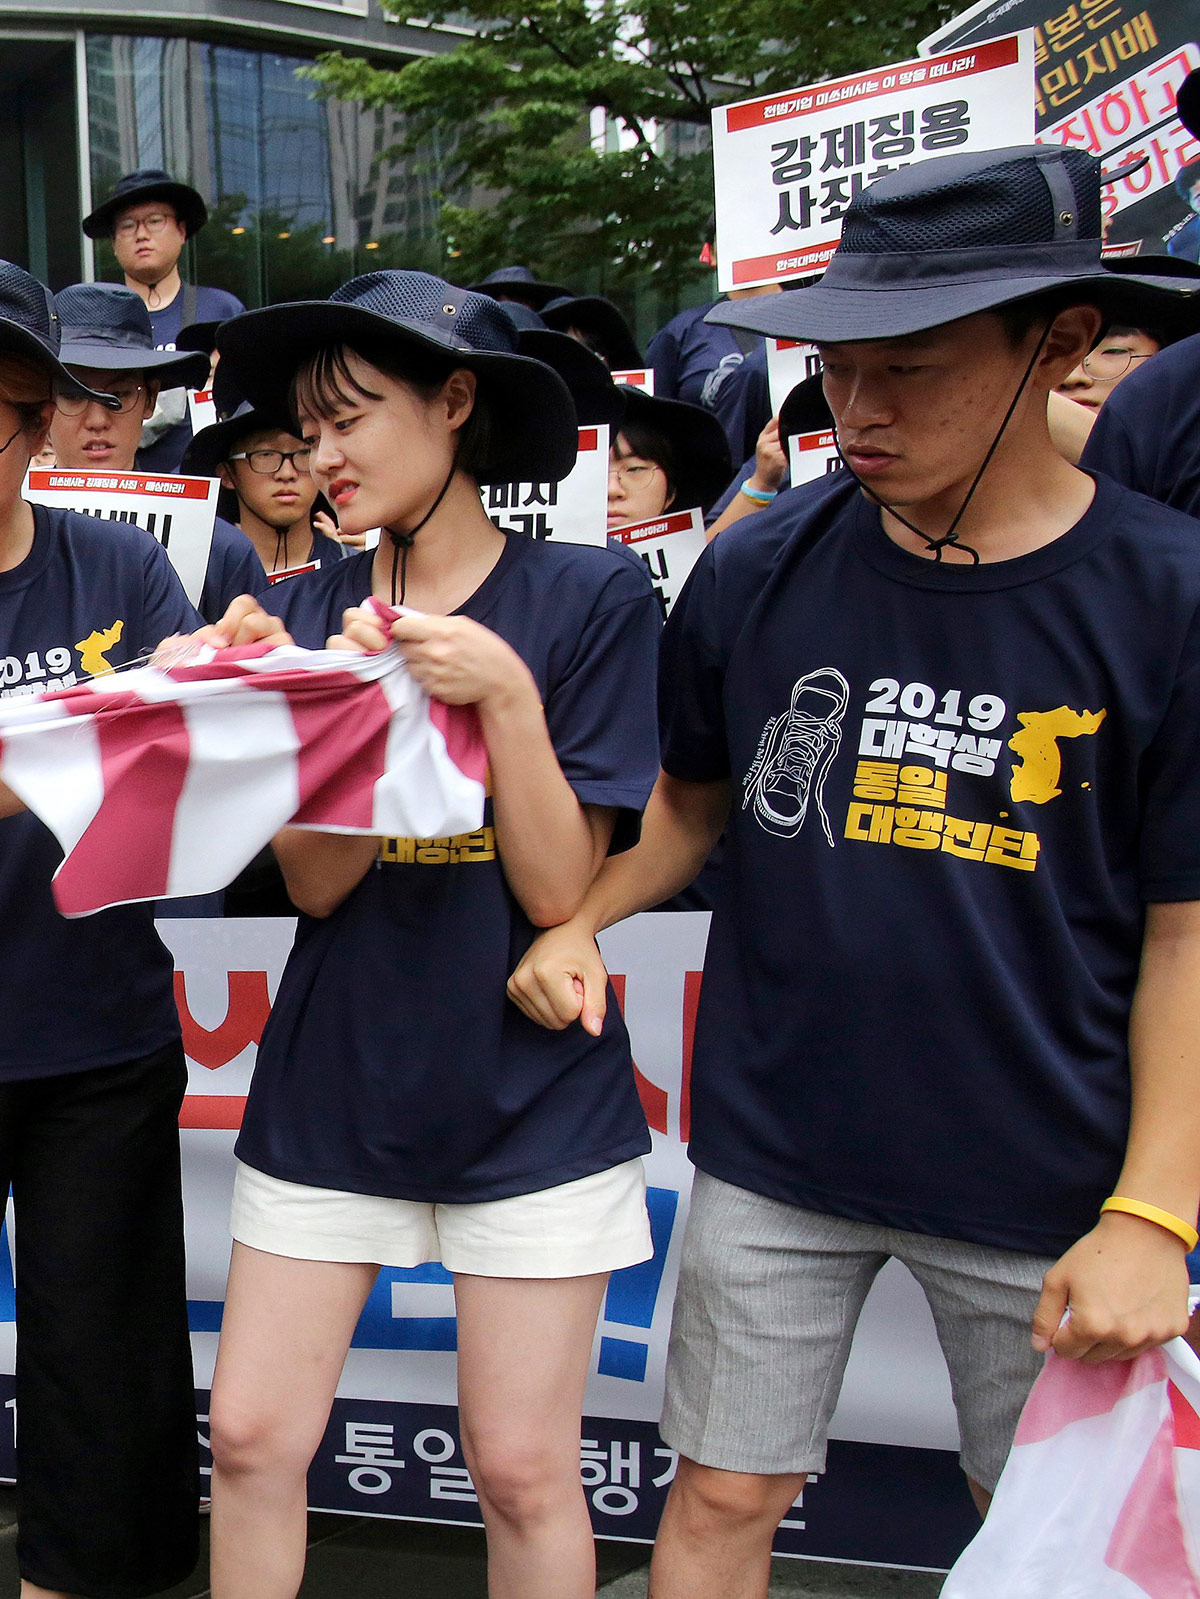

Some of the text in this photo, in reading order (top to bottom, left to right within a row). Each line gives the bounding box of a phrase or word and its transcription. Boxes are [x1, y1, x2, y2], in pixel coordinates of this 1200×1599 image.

[763, 55, 976, 119] 전범기업 미쓰비시는 이 땅을 떠나라!
[770, 100, 971, 186] 강제징용
[49, 476, 85, 488] 미쓰비시는
[118, 479, 138, 490] 사죄
[145, 482, 185, 494] 배상하라!
[865, 677, 1006, 731] 2019
[857, 717, 1003, 778] 대학생
[853, 760, 948, 809] 통일
[844, 801, 1041, 872] 대행진단
